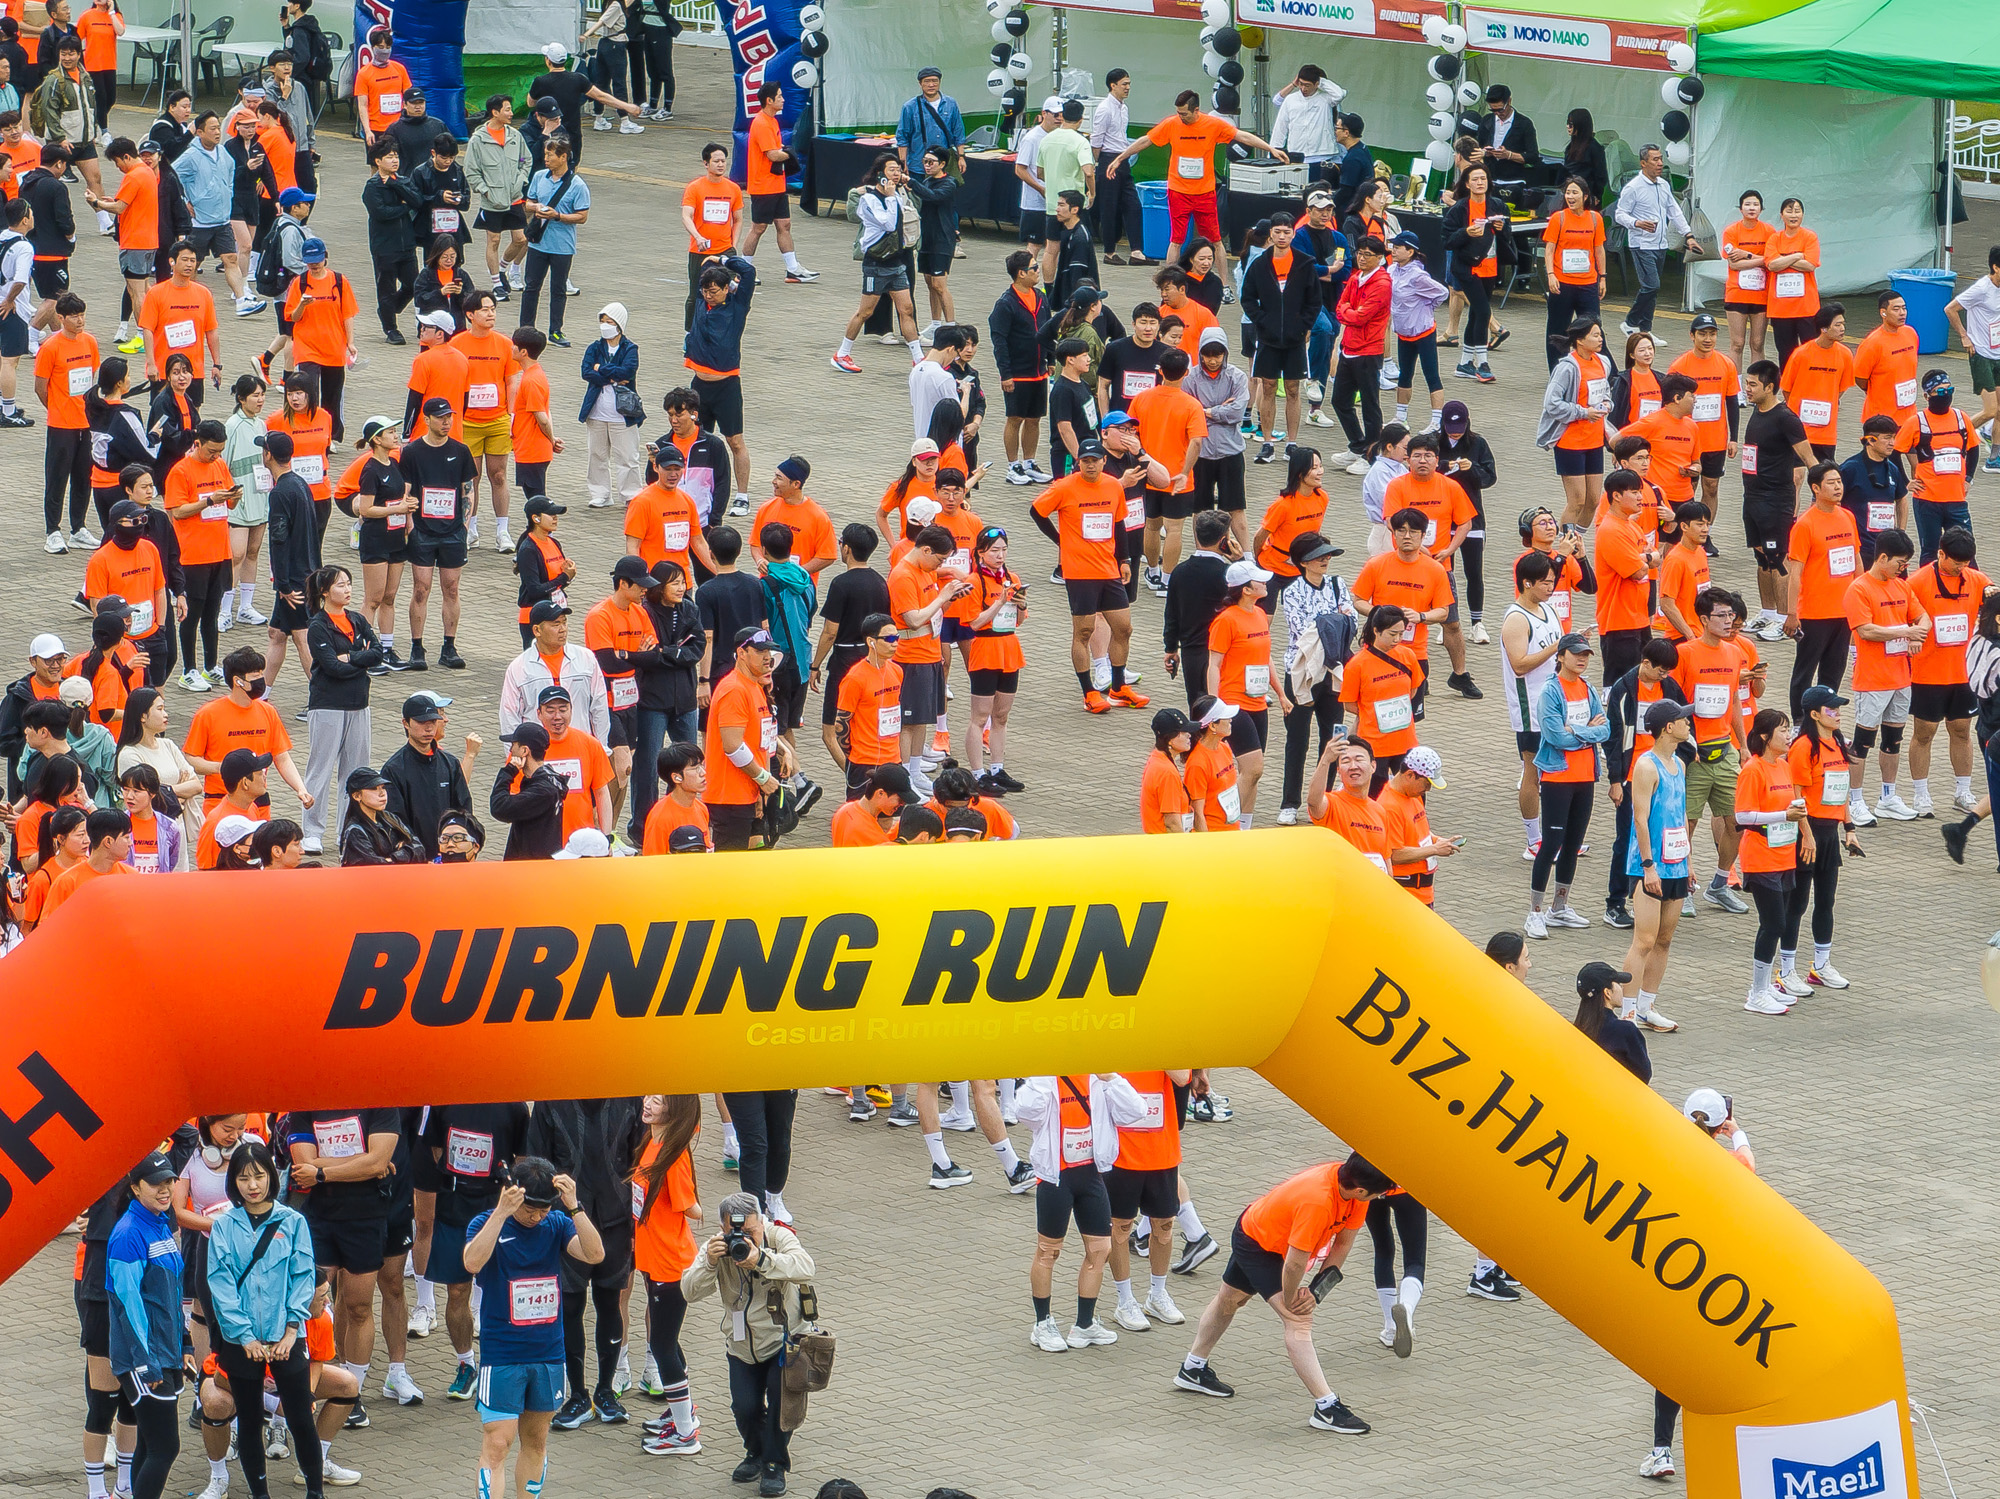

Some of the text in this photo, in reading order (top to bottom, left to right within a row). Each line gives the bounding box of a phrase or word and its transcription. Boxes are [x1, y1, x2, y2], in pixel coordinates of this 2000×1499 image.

[1281, 1, 1354, 21] MONO MANO
[1379, 9, 1420, 24] BURNING
[1514, 26, 1590, 47] MONO MANO
[1616, 35, 1660, 51] BURNING
[176, 330, 192, 338] 2125
[673, 531, 688, 539] 1784
[1373, 673, 1397, 682] BURNING
[324, 902, 1169, 1030] BURNING RUN
[746, 1006, 1136, 1046] Casual Running Festival
[327, 1133, 356, 1144] 1757
[459, 1146, 487, 1158] 1230
[1336, 968, 1797, 1369] BIZ.HANKOOK
[528, 1293, 555, 1305] 1413
[1783, 1457, 1879, 1499] Maeil
